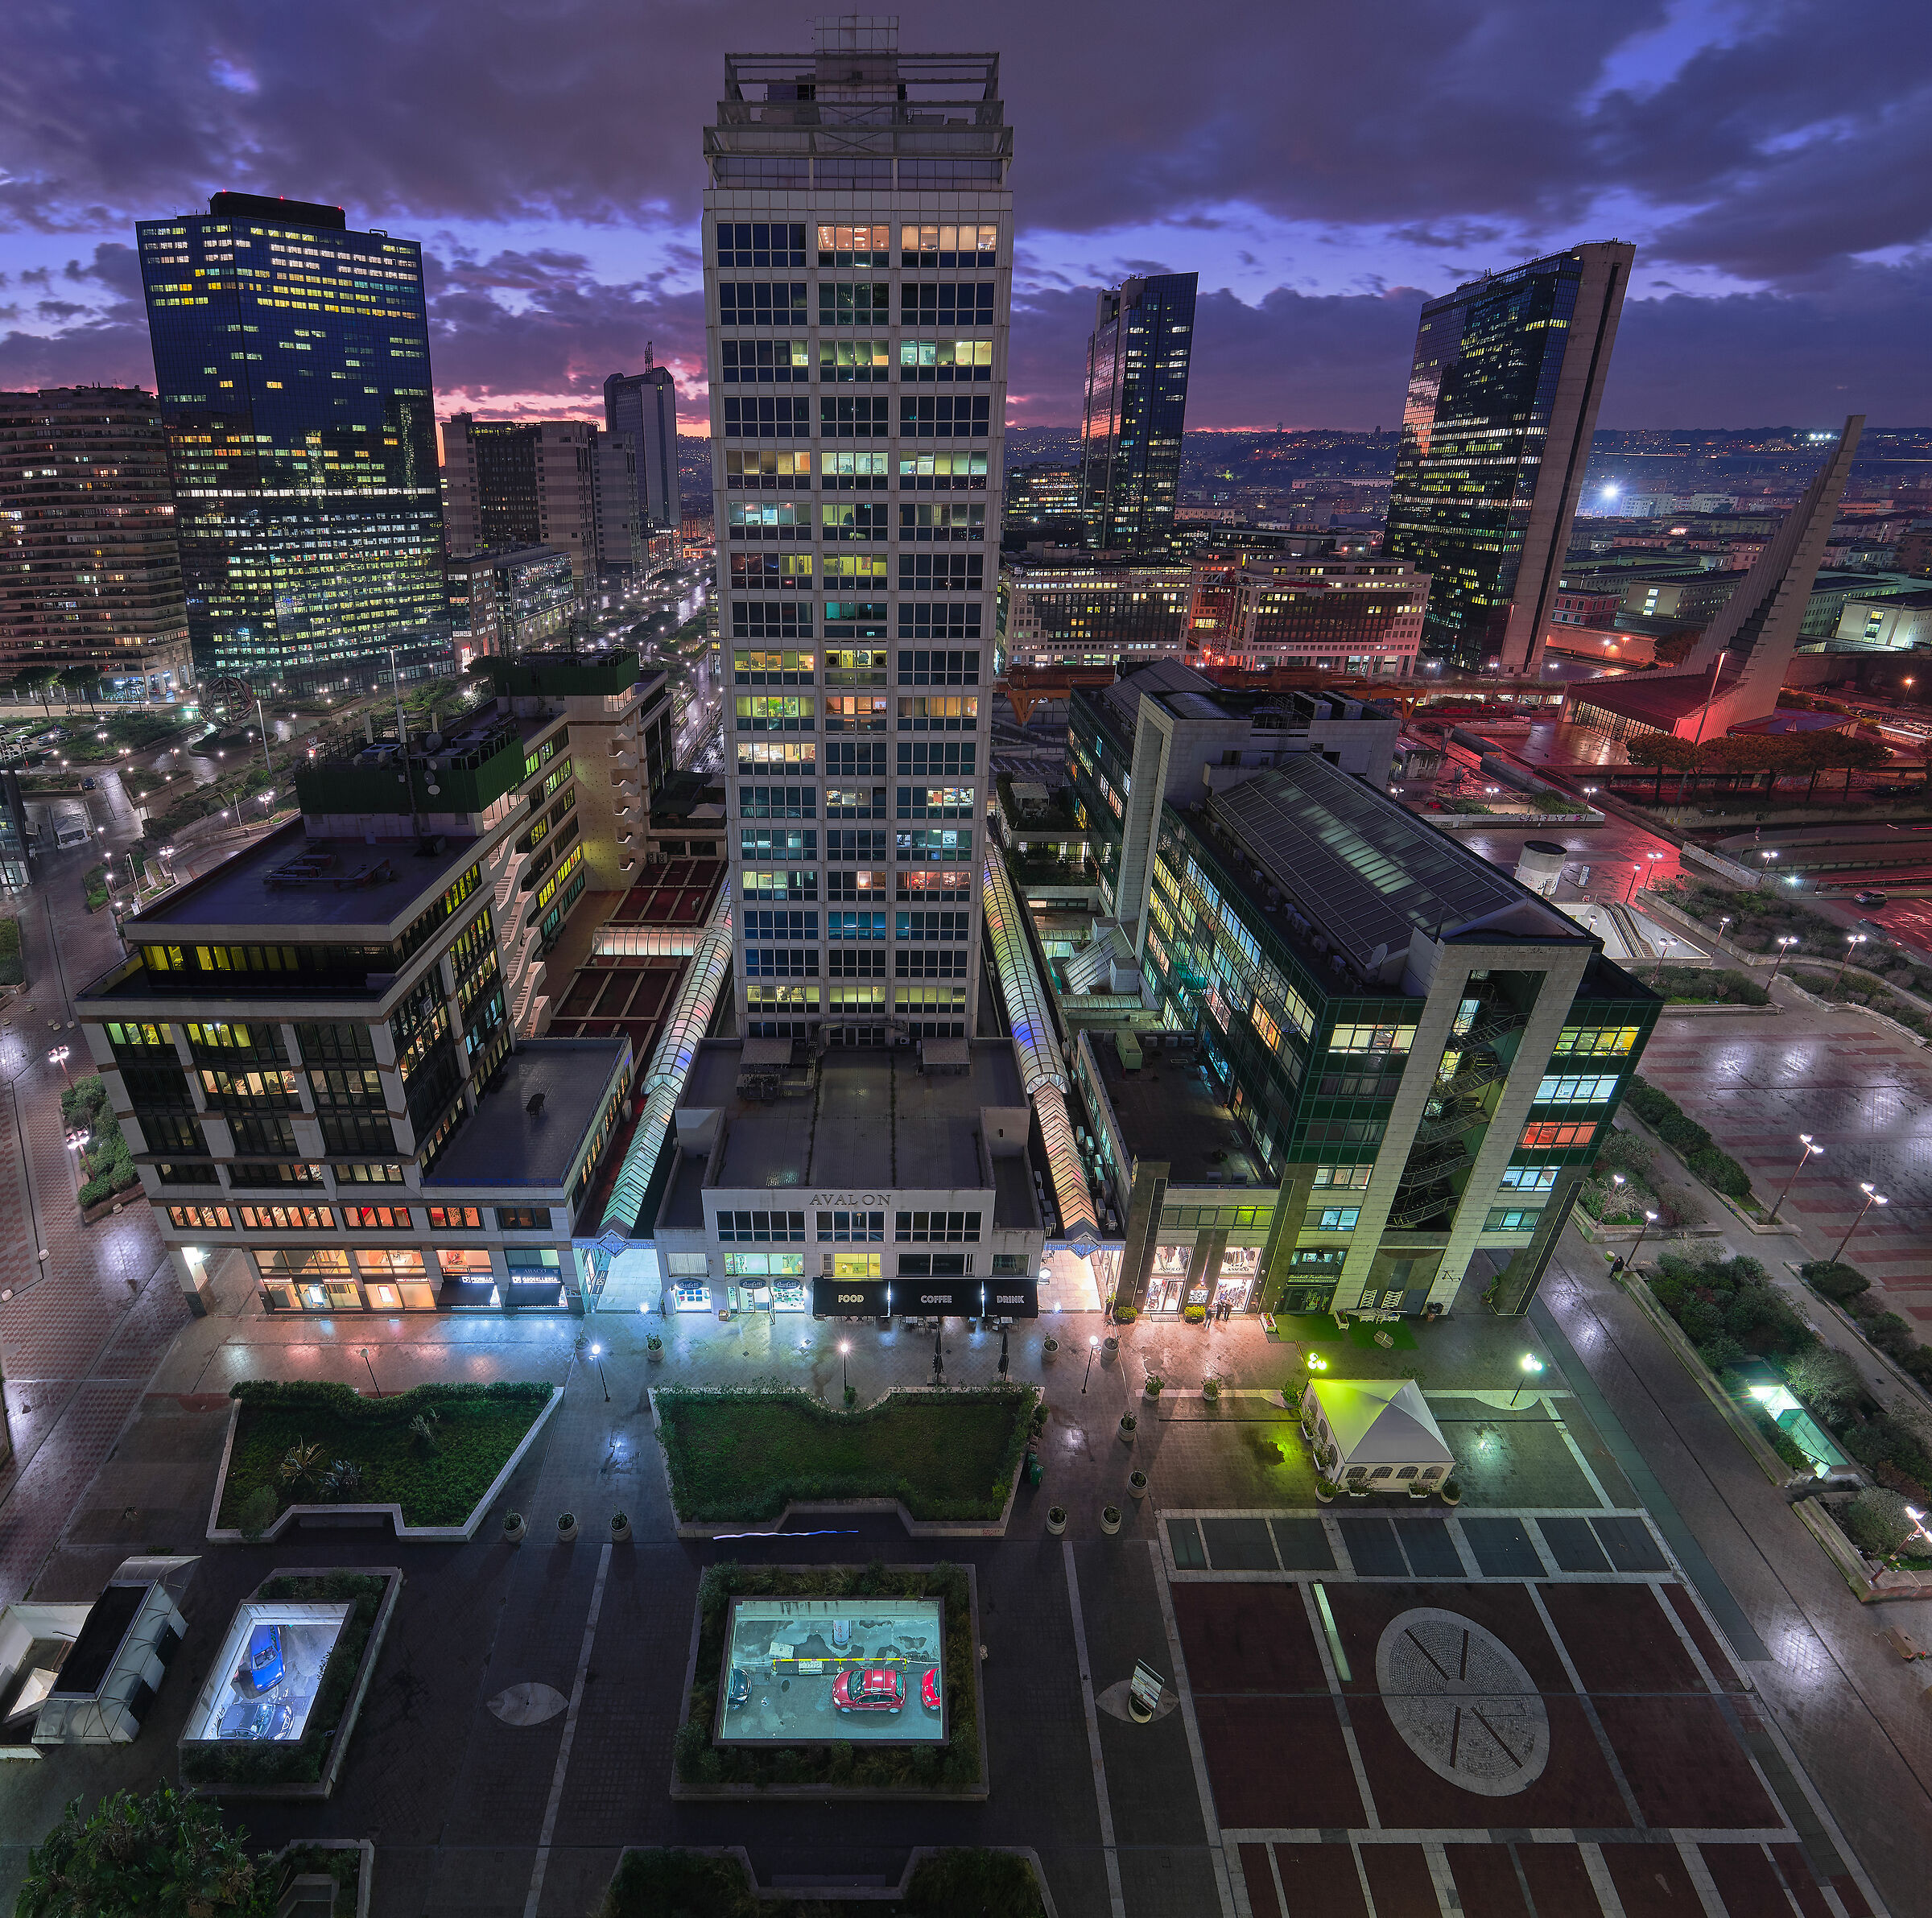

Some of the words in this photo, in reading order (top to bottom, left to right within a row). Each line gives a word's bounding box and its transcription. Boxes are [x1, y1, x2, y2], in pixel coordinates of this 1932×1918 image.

[809, 1194, 892, 1206] AVALON
[838, 1294, 864, 1303] FOOD
[920, 1295, 952, 1304] COFFEE
[997, 1295, 1025, 1304] DRINK
